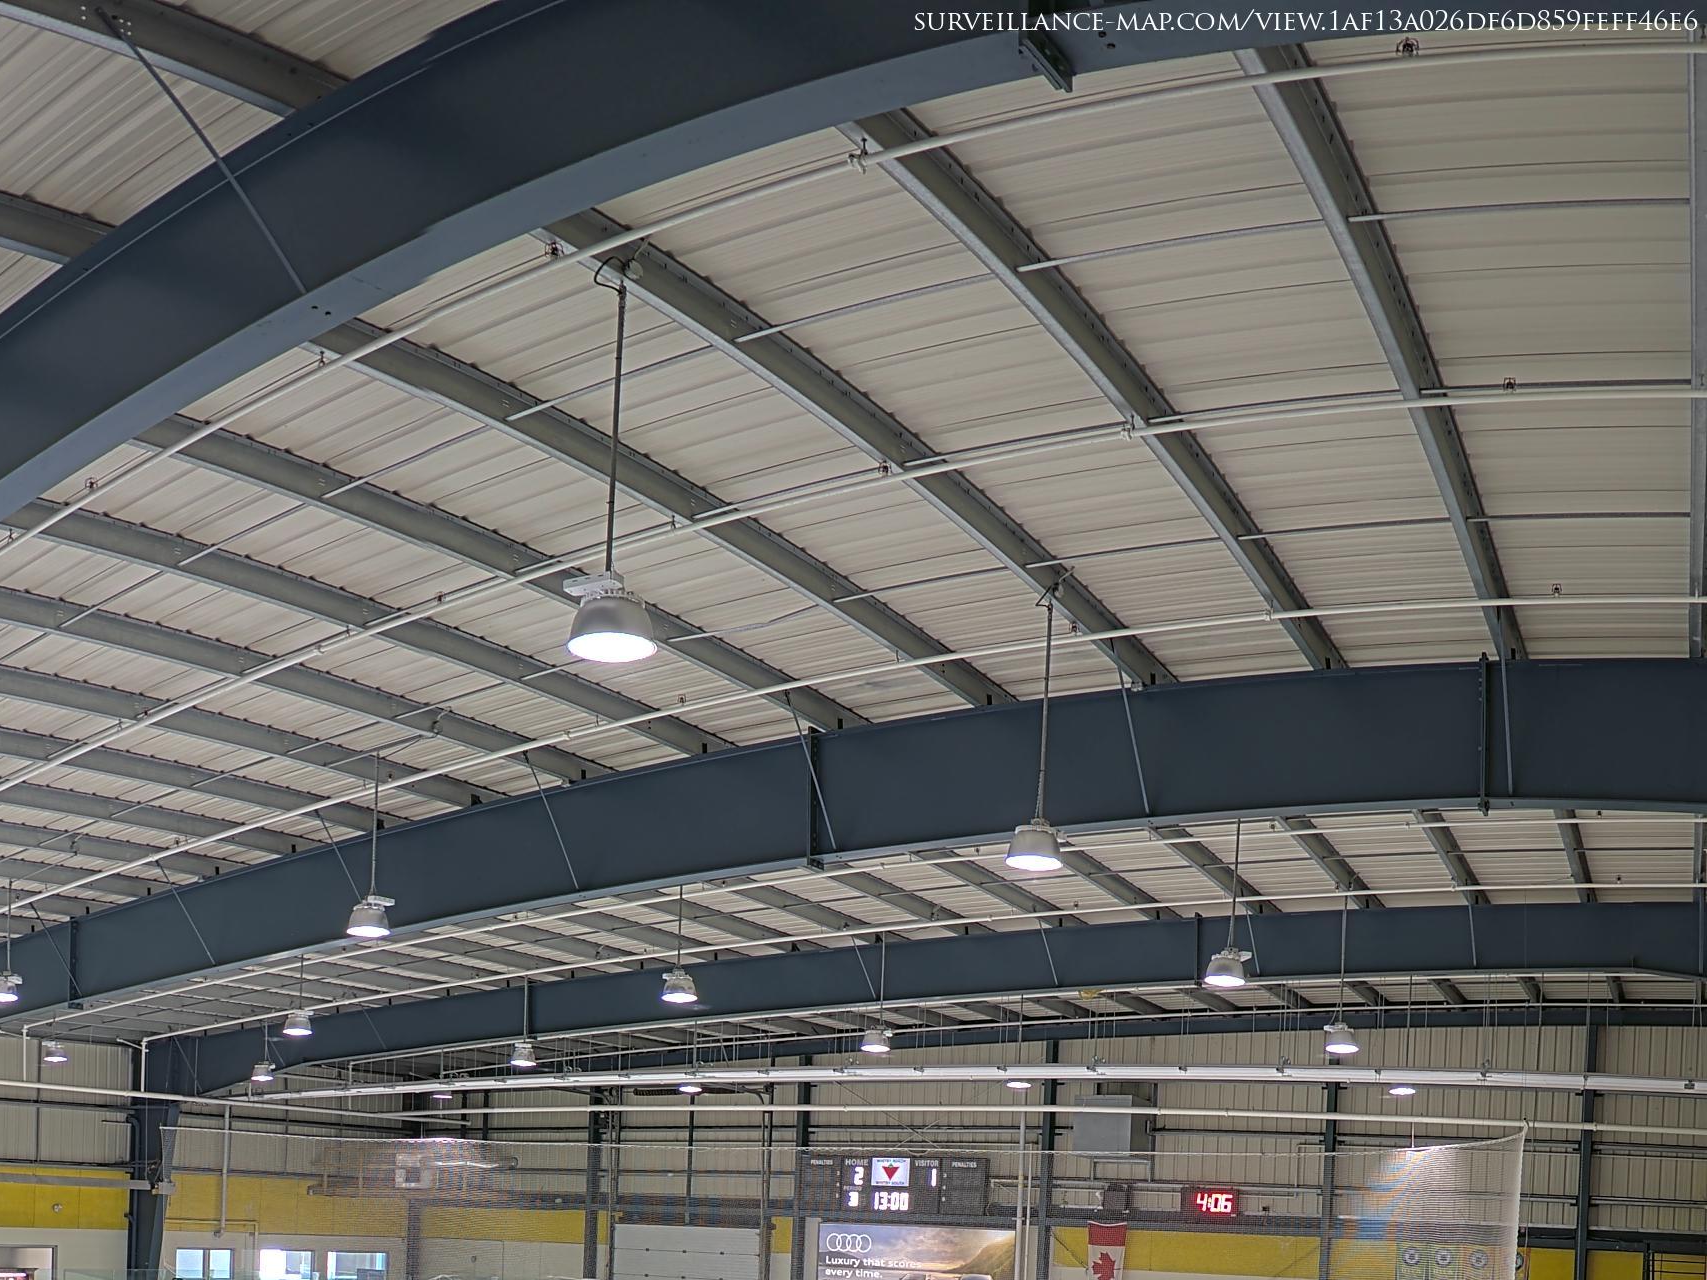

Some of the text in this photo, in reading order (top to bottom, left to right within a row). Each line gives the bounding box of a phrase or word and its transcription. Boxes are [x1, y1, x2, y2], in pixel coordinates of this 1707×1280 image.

[845, 1158, 939, 1167] HOME VISITOR
[951, 1161, 977, 1169] PENALTIES
[1196, 1192, 1233, 1213] 4:06
[825, 1255, 922, 1269] Luxury that scores
[825, 1268, 883, 1279] every time.
